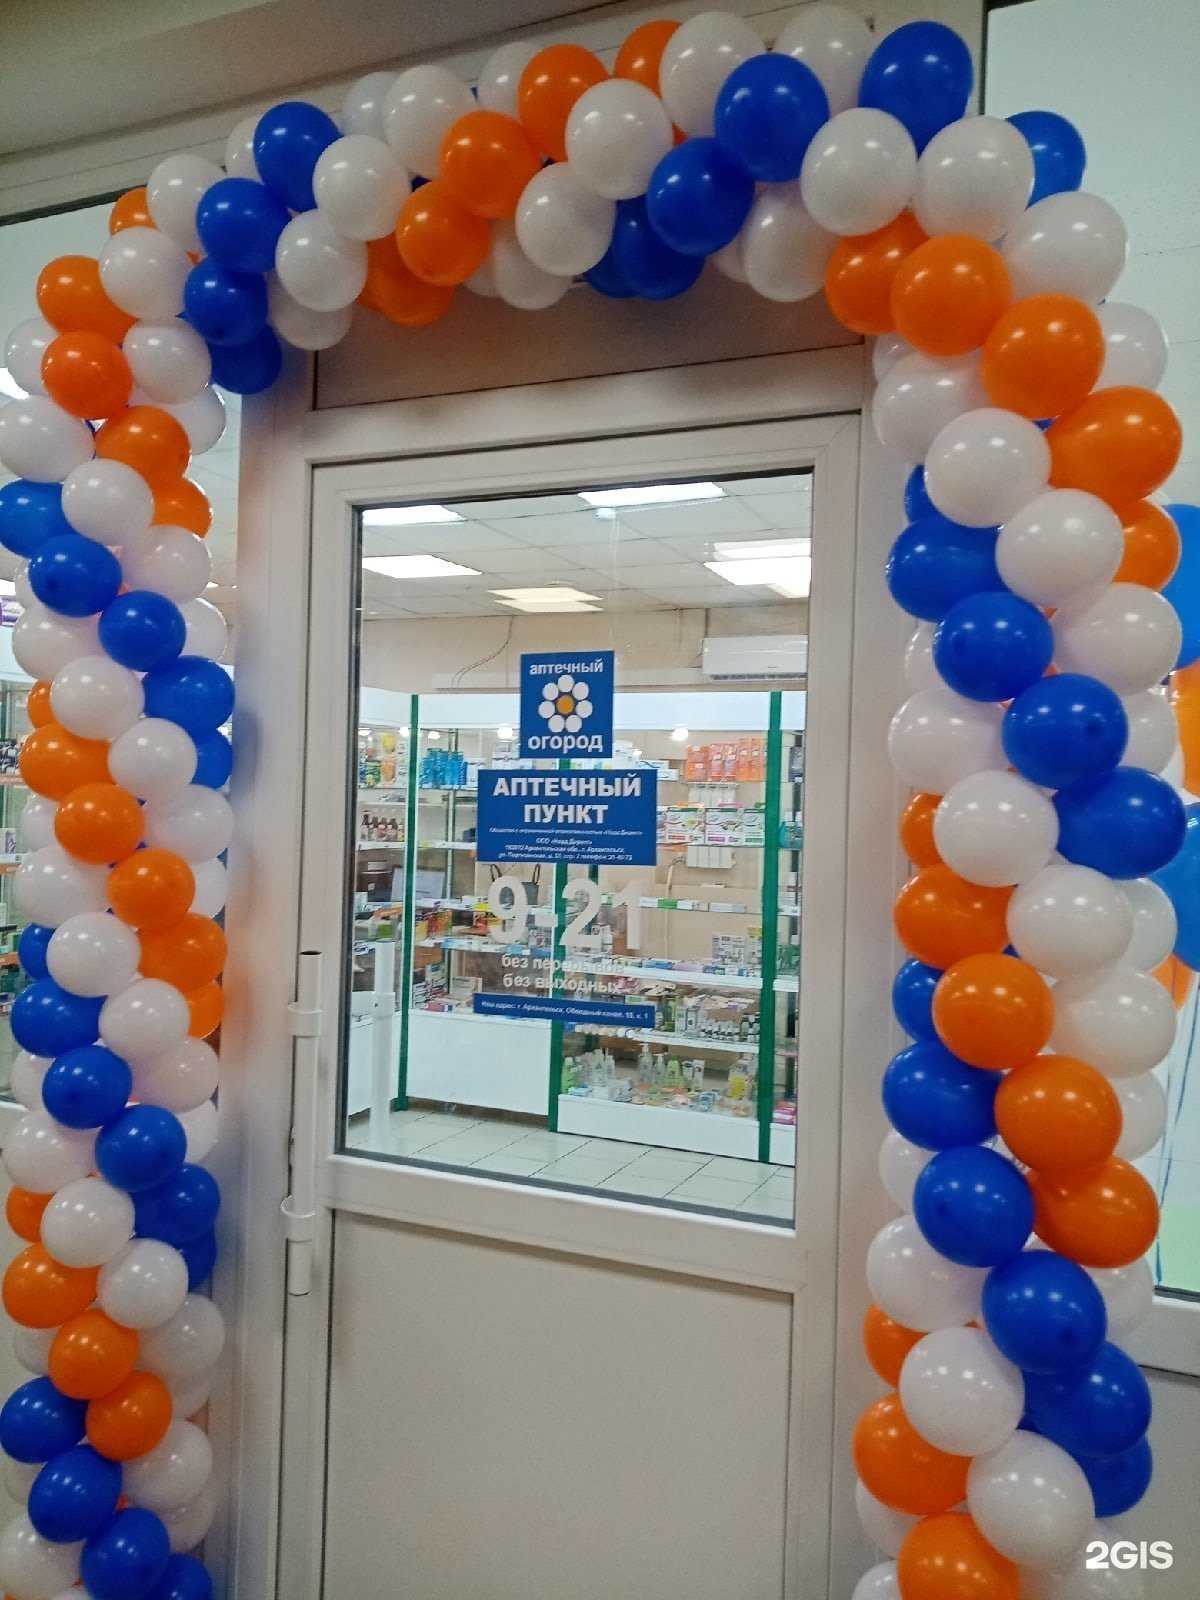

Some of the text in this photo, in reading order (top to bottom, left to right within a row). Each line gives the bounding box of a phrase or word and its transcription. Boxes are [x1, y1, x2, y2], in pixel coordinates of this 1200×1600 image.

[529, 659, 604, 675] аптечный
[527, 734, 603, 753] огород
[493, 773, 641, 797] АПТЕЧНЫЙ
[524, 804, 609, 824] ПУНКТ
[501, 953, 529, 969] без
[503, 973, 530, 988] без
